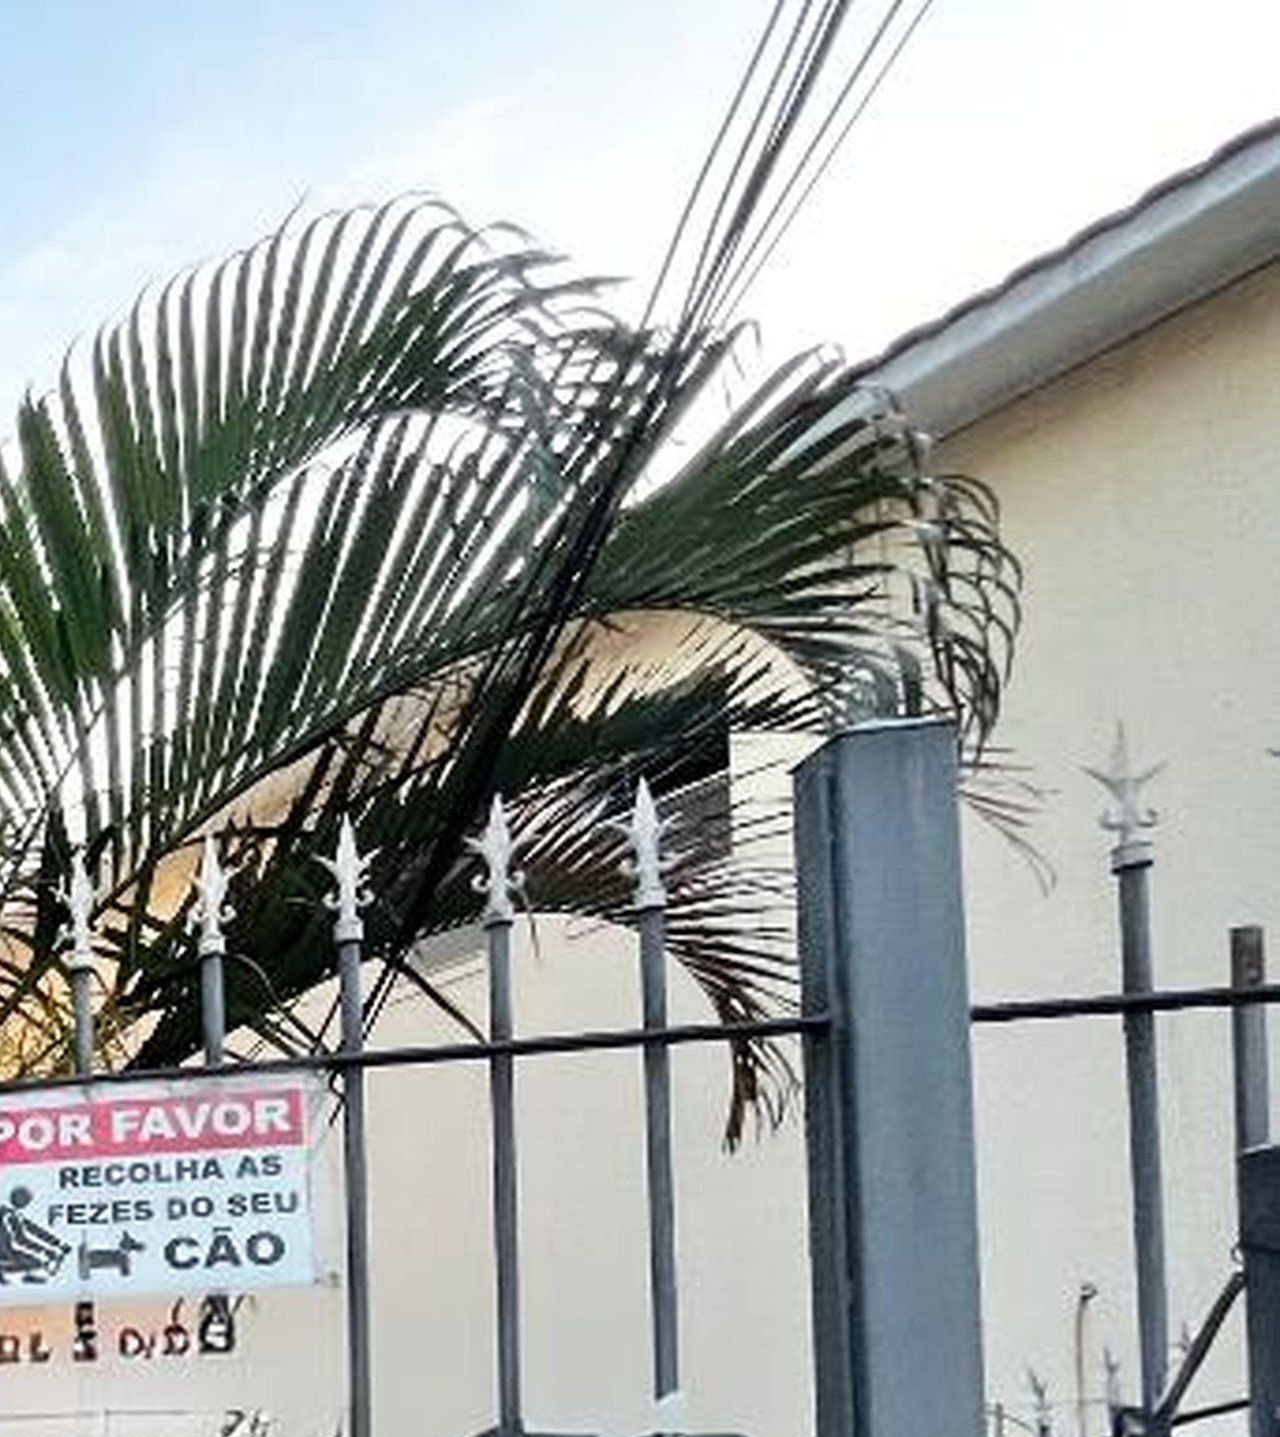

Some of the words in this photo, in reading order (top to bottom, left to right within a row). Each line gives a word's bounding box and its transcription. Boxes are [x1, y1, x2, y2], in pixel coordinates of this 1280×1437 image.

[111, 1097, 291, 1143] FAVOR
[58, 1158, 225, 1189] RECOLHA
[235, 1154, 283, 1179] AS
[47, 1198, 155, 1226] FEZES
[166, 1196, 215, 1222] DO
[227, 1191, 300, 1217] SEU
[163, 1226, 287, 1270] CÃO
